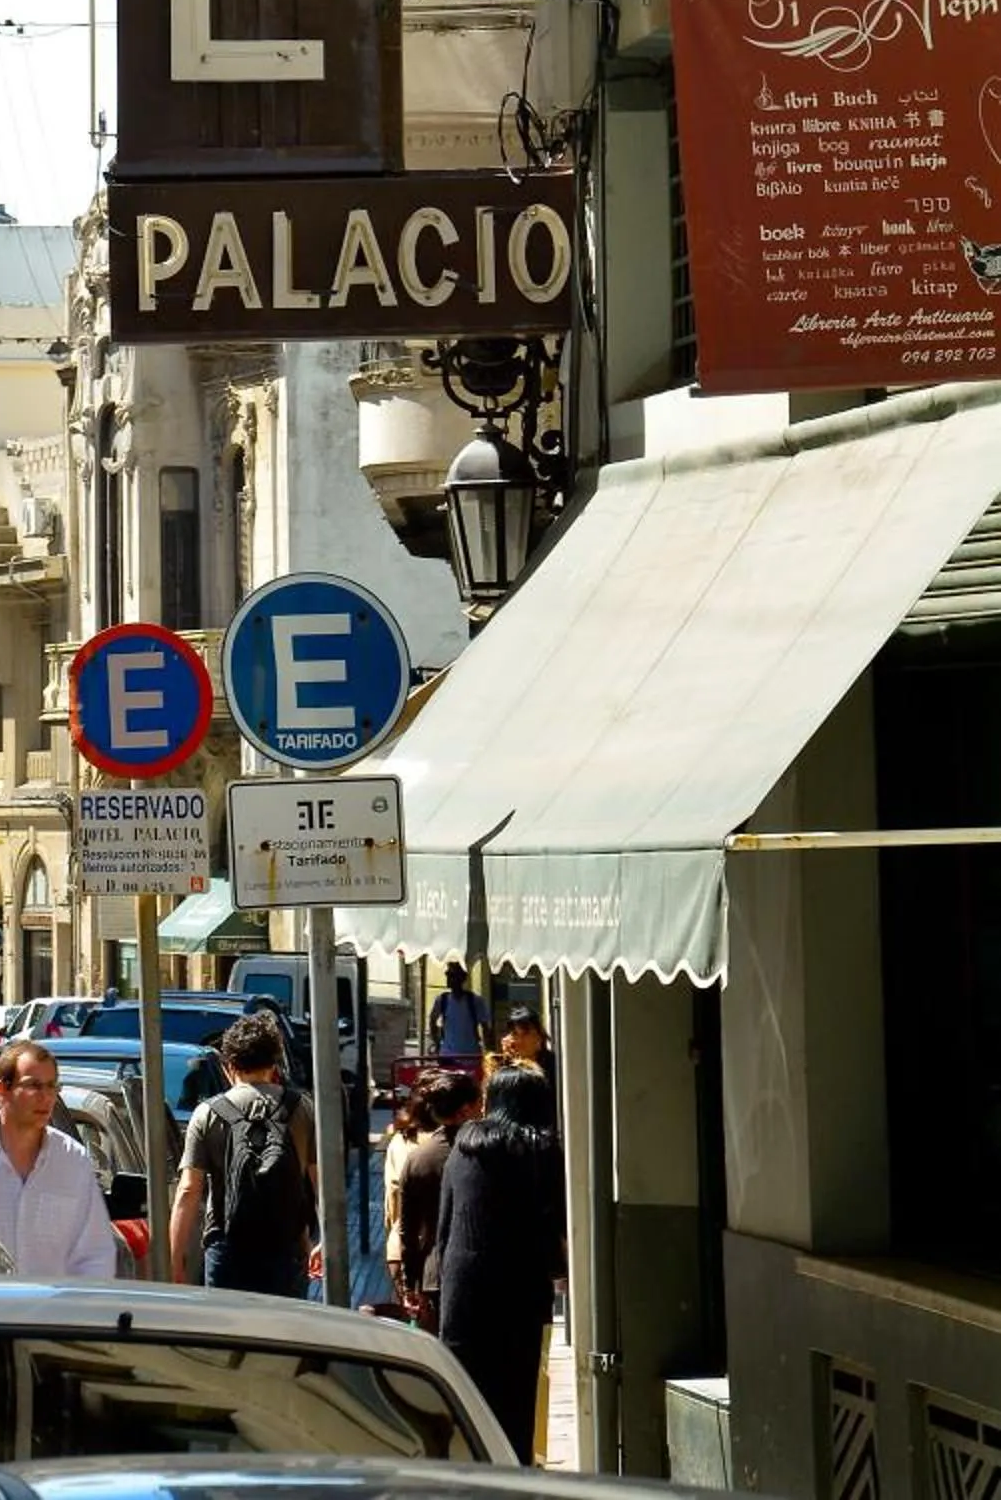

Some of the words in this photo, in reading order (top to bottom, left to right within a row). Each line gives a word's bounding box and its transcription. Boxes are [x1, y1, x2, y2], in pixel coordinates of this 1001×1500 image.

[833, 88, 878, 108] Buch
[848, 116, 897, 132] KNIHA
[752, 141, 800, 158] knjiga
[818, 137, 849, 154] bog
[868, 133, 944, 150] raamat
[786, 160, 823, 175] livre
[833, 155, 903, 173] bouquin
[759, 223, 805, 241] boek
[135, 203, 572, 311] PALACIO
[911, 277, 959, 299] kitap
[862, 308, 903, 329] Arte
[967, 346, 997, 362] 703
[272, 613, 356, 730] E
[106, 652, 169, 749] E
[276, 732, 358, 750] TARIFADO
[80, 795, 205, 820] RESERVADO
[286, 853, 347, 868] Tarifado
